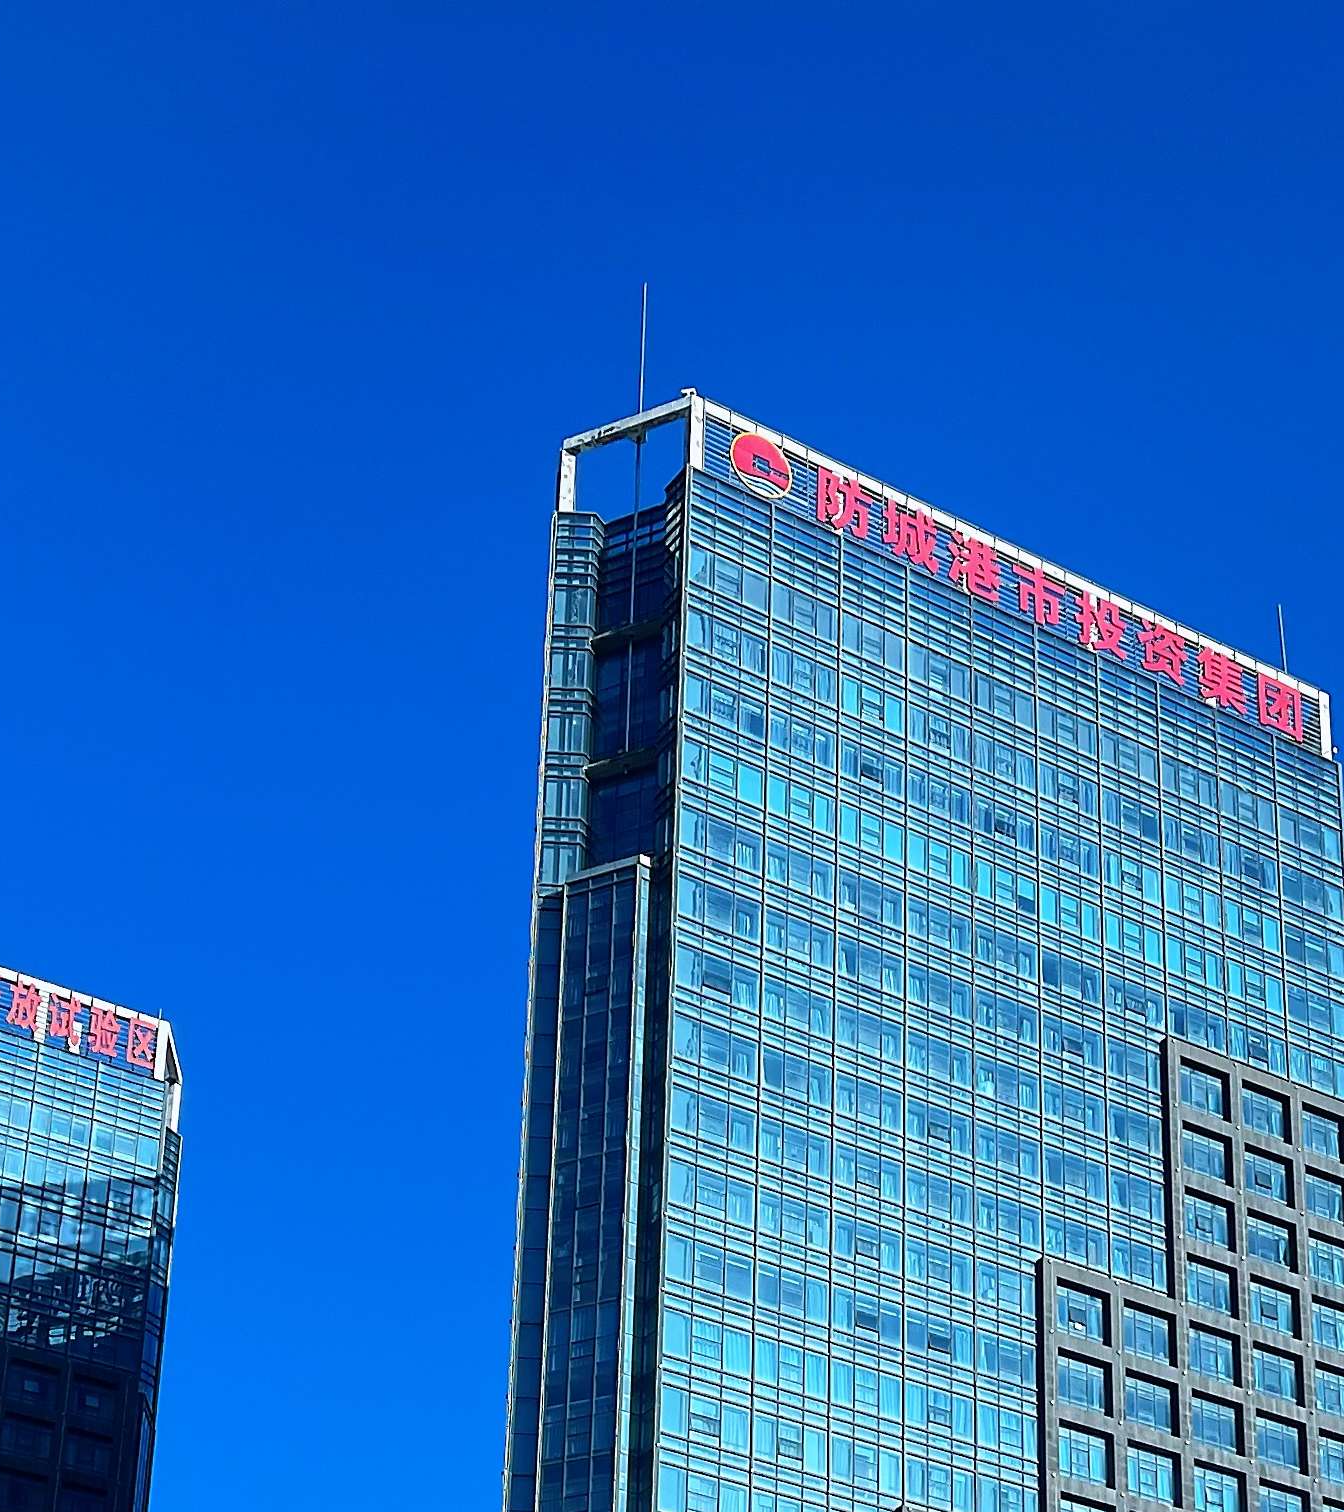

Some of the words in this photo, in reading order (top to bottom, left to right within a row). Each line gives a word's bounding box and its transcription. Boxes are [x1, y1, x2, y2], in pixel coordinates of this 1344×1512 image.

[816, 465, 1305, 743] 防城港市投资集团
